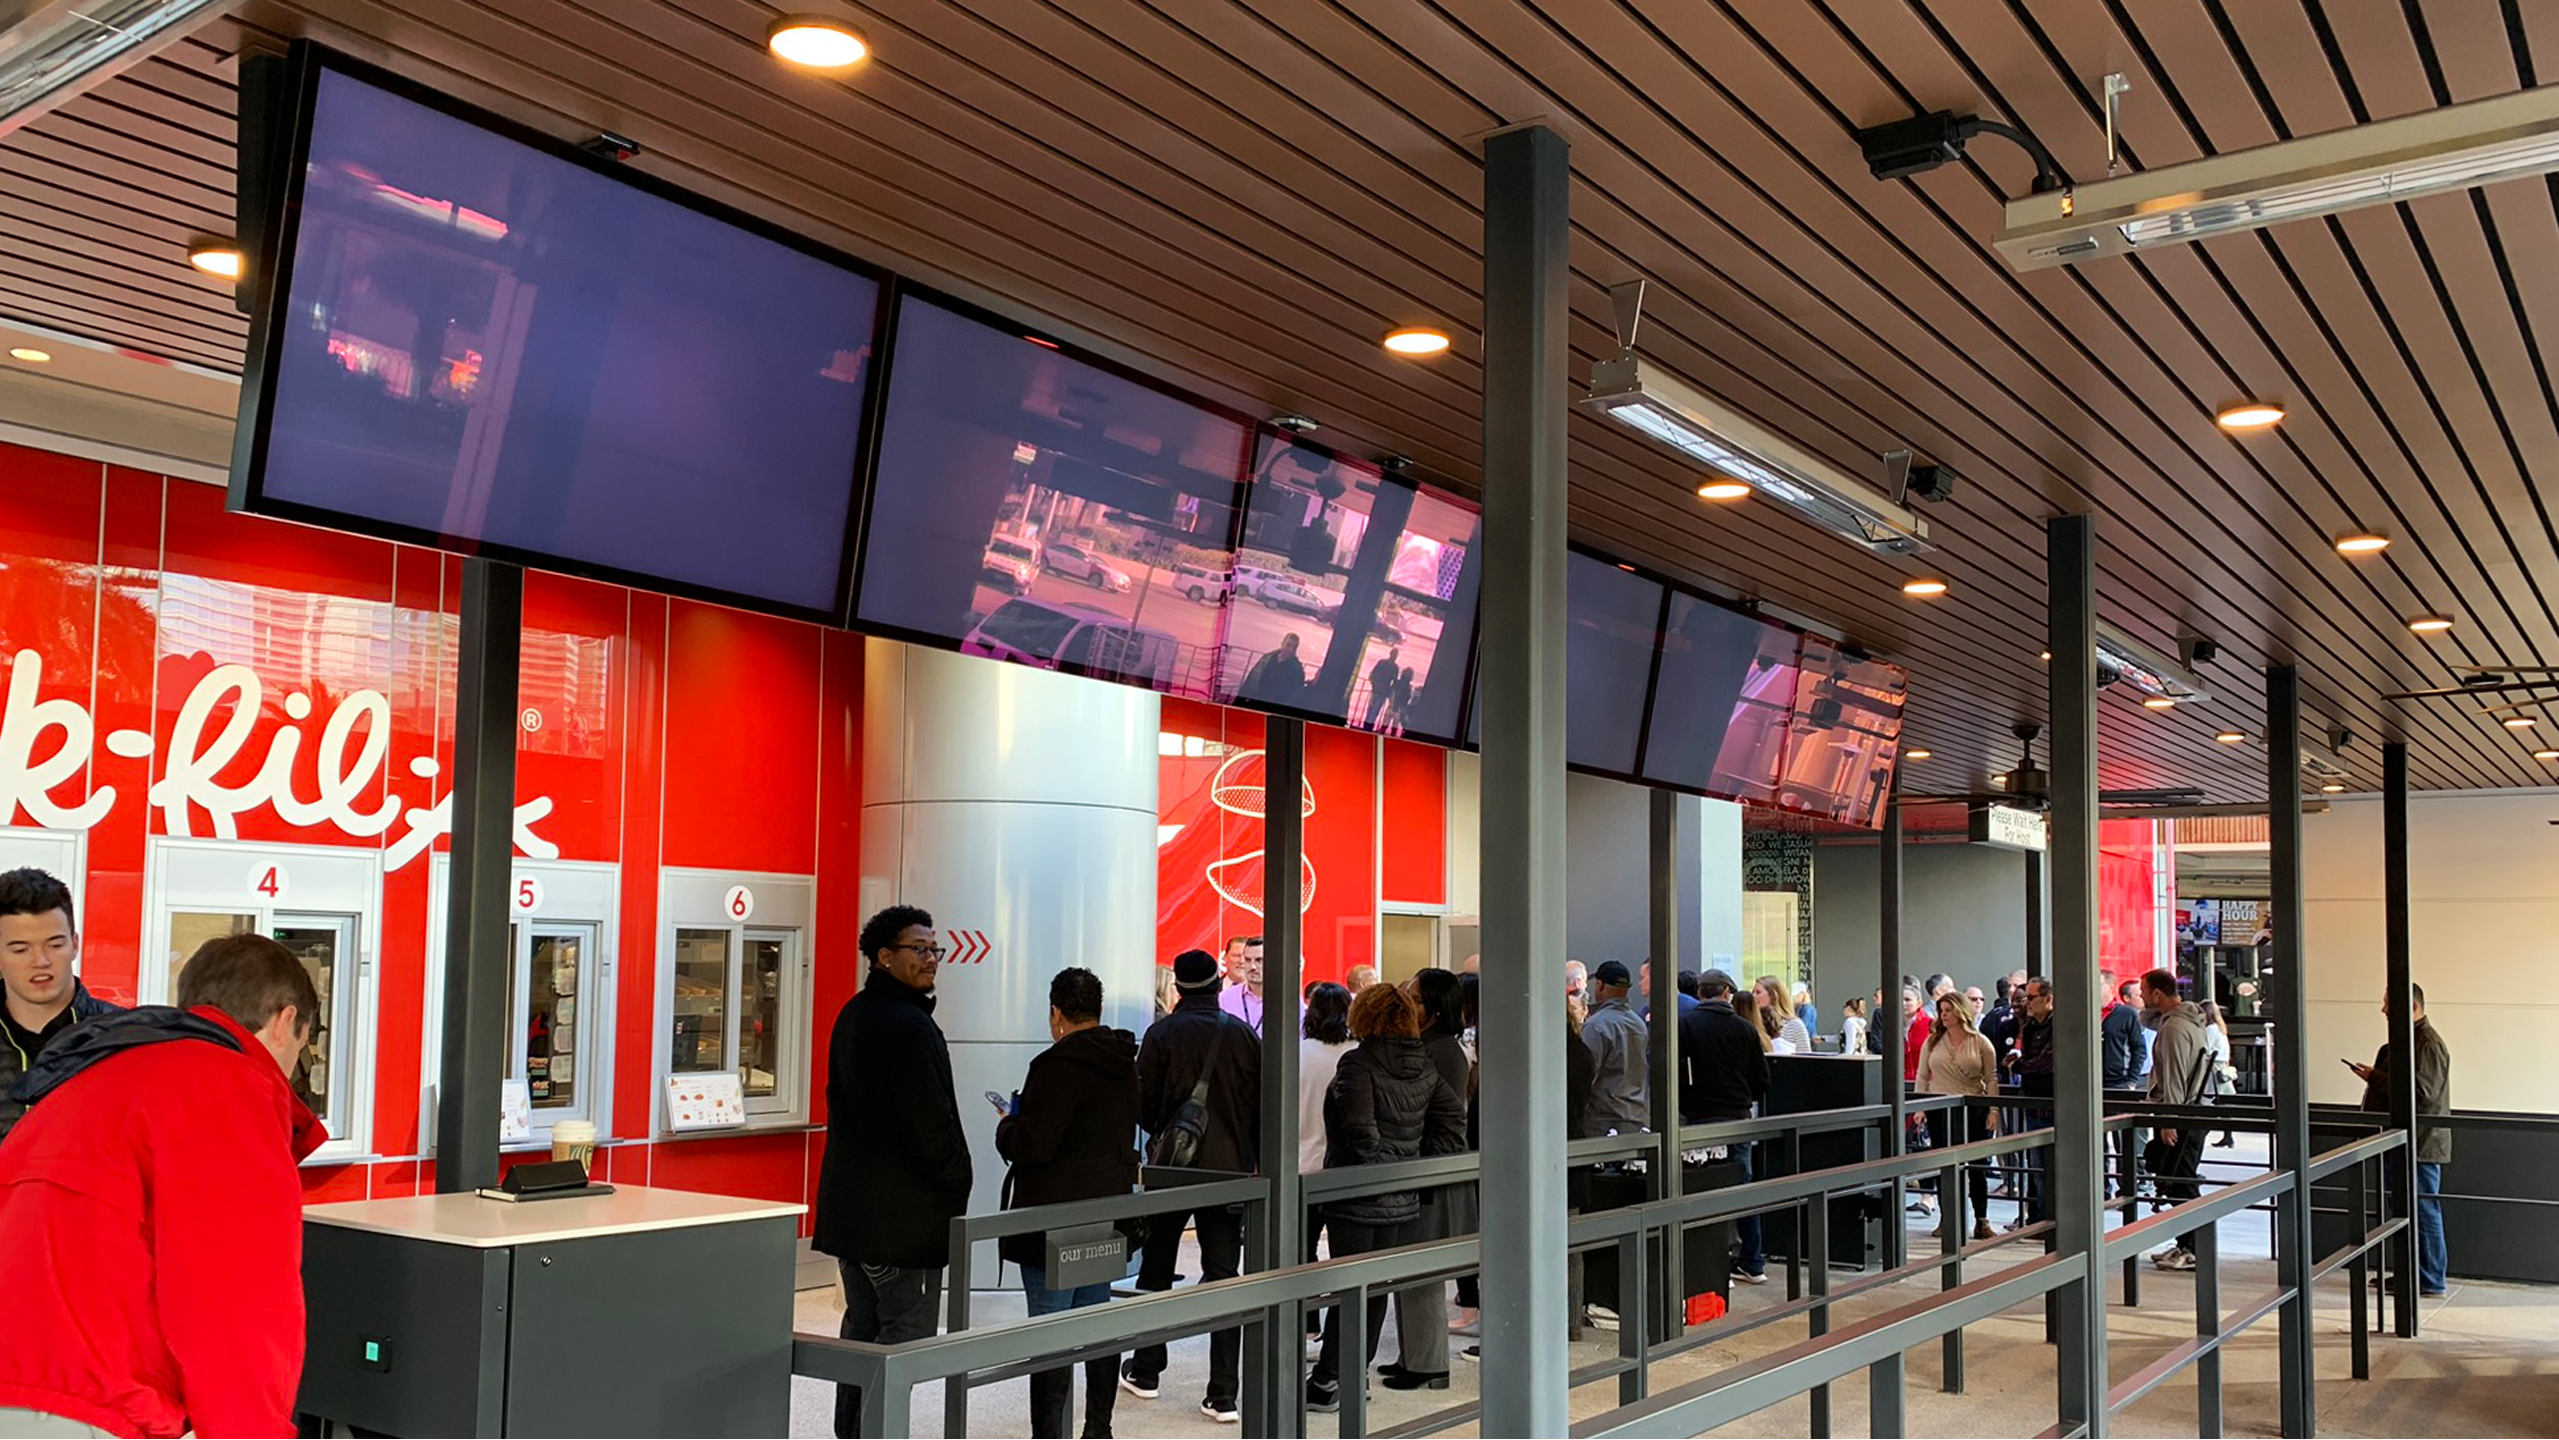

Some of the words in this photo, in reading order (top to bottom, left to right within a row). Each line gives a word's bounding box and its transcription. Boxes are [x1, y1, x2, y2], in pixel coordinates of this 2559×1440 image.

[1991, 808, 2012, 826] Please
[2013, 811, 2029, 829] Wait
[2029, 815, 2043, 832] Here
[2004, 826, 2015, 841] For
[2017, 829, 2031, 846] Host
[257, 866, 279, 898] 4
[518, 880, 535, 908] 5
[732, 890, 746, 916] 6
[2222, 901, 2258, 910] HAPPY
[2222, 910, 2258, 921] HOUR
[1060, 1248, 1082, 1263] our
[1085, 1242, 1121, 1259] menu
